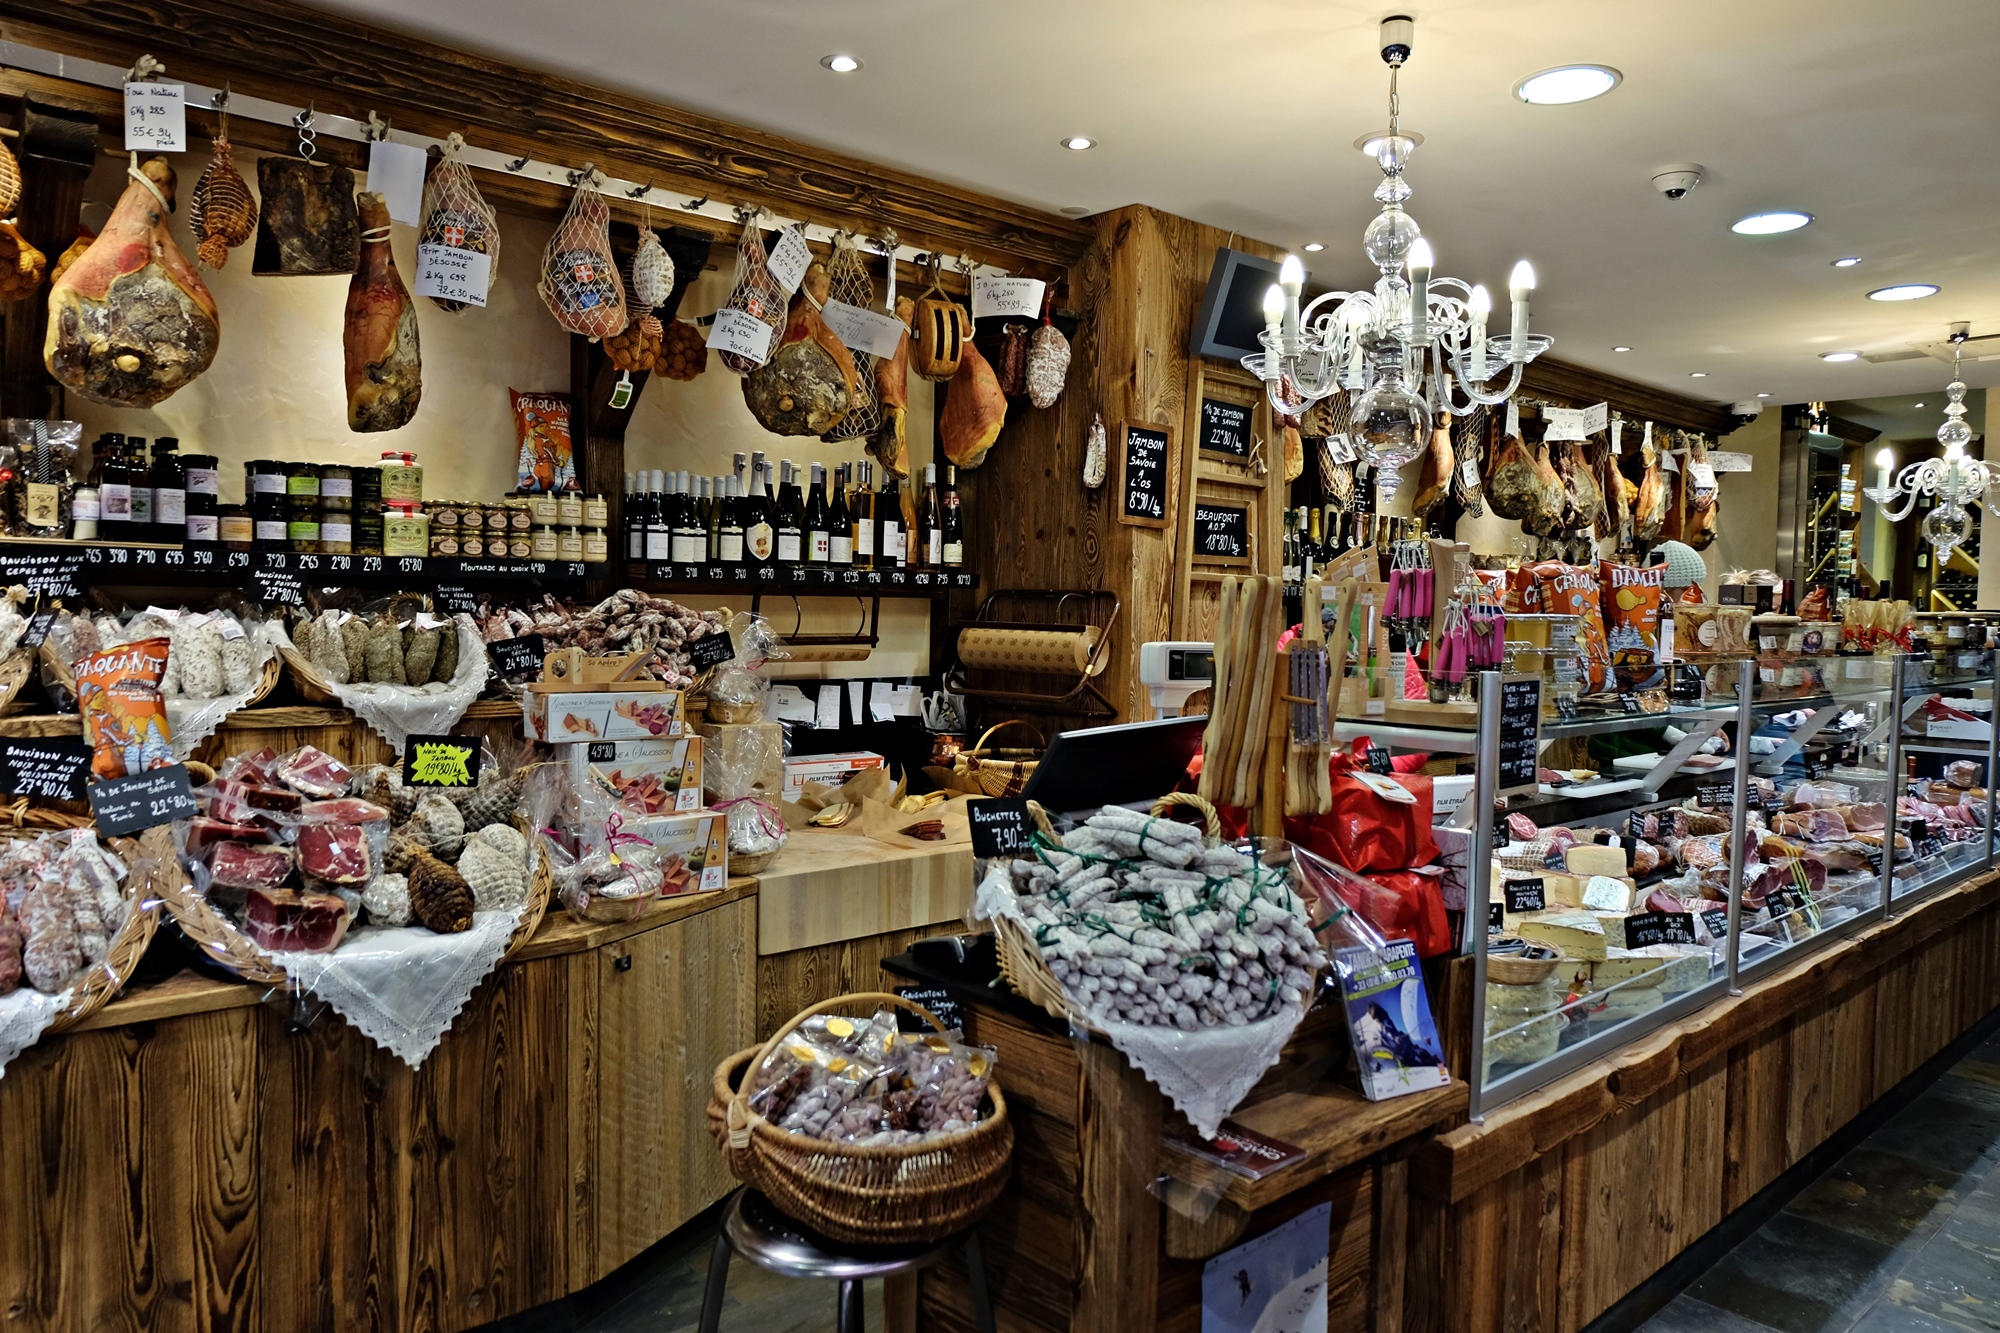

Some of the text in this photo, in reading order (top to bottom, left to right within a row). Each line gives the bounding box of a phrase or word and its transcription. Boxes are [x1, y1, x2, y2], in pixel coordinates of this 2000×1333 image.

[1221, 409, 1244, 420] JAMBON
[1222, 419, 1240, 427] SAVOIE
[1128, 432, 1164, 451] JAMBON
[1137, 449, 1148, 457] DE
[1129, 456, 1156, 468] SAVOIE
[1196, 510, 1240, 523] BEAUFORT
[591, 744, 614, 758] 49€80
[8, 758, 35, 770] NOIX
[57, 764, 77, 774] AUX
[66, 755, 85, 765] AUX
[121, 780, 152, 793] JAMBON
[974, 806, 1021, 822] BUCHETTES
